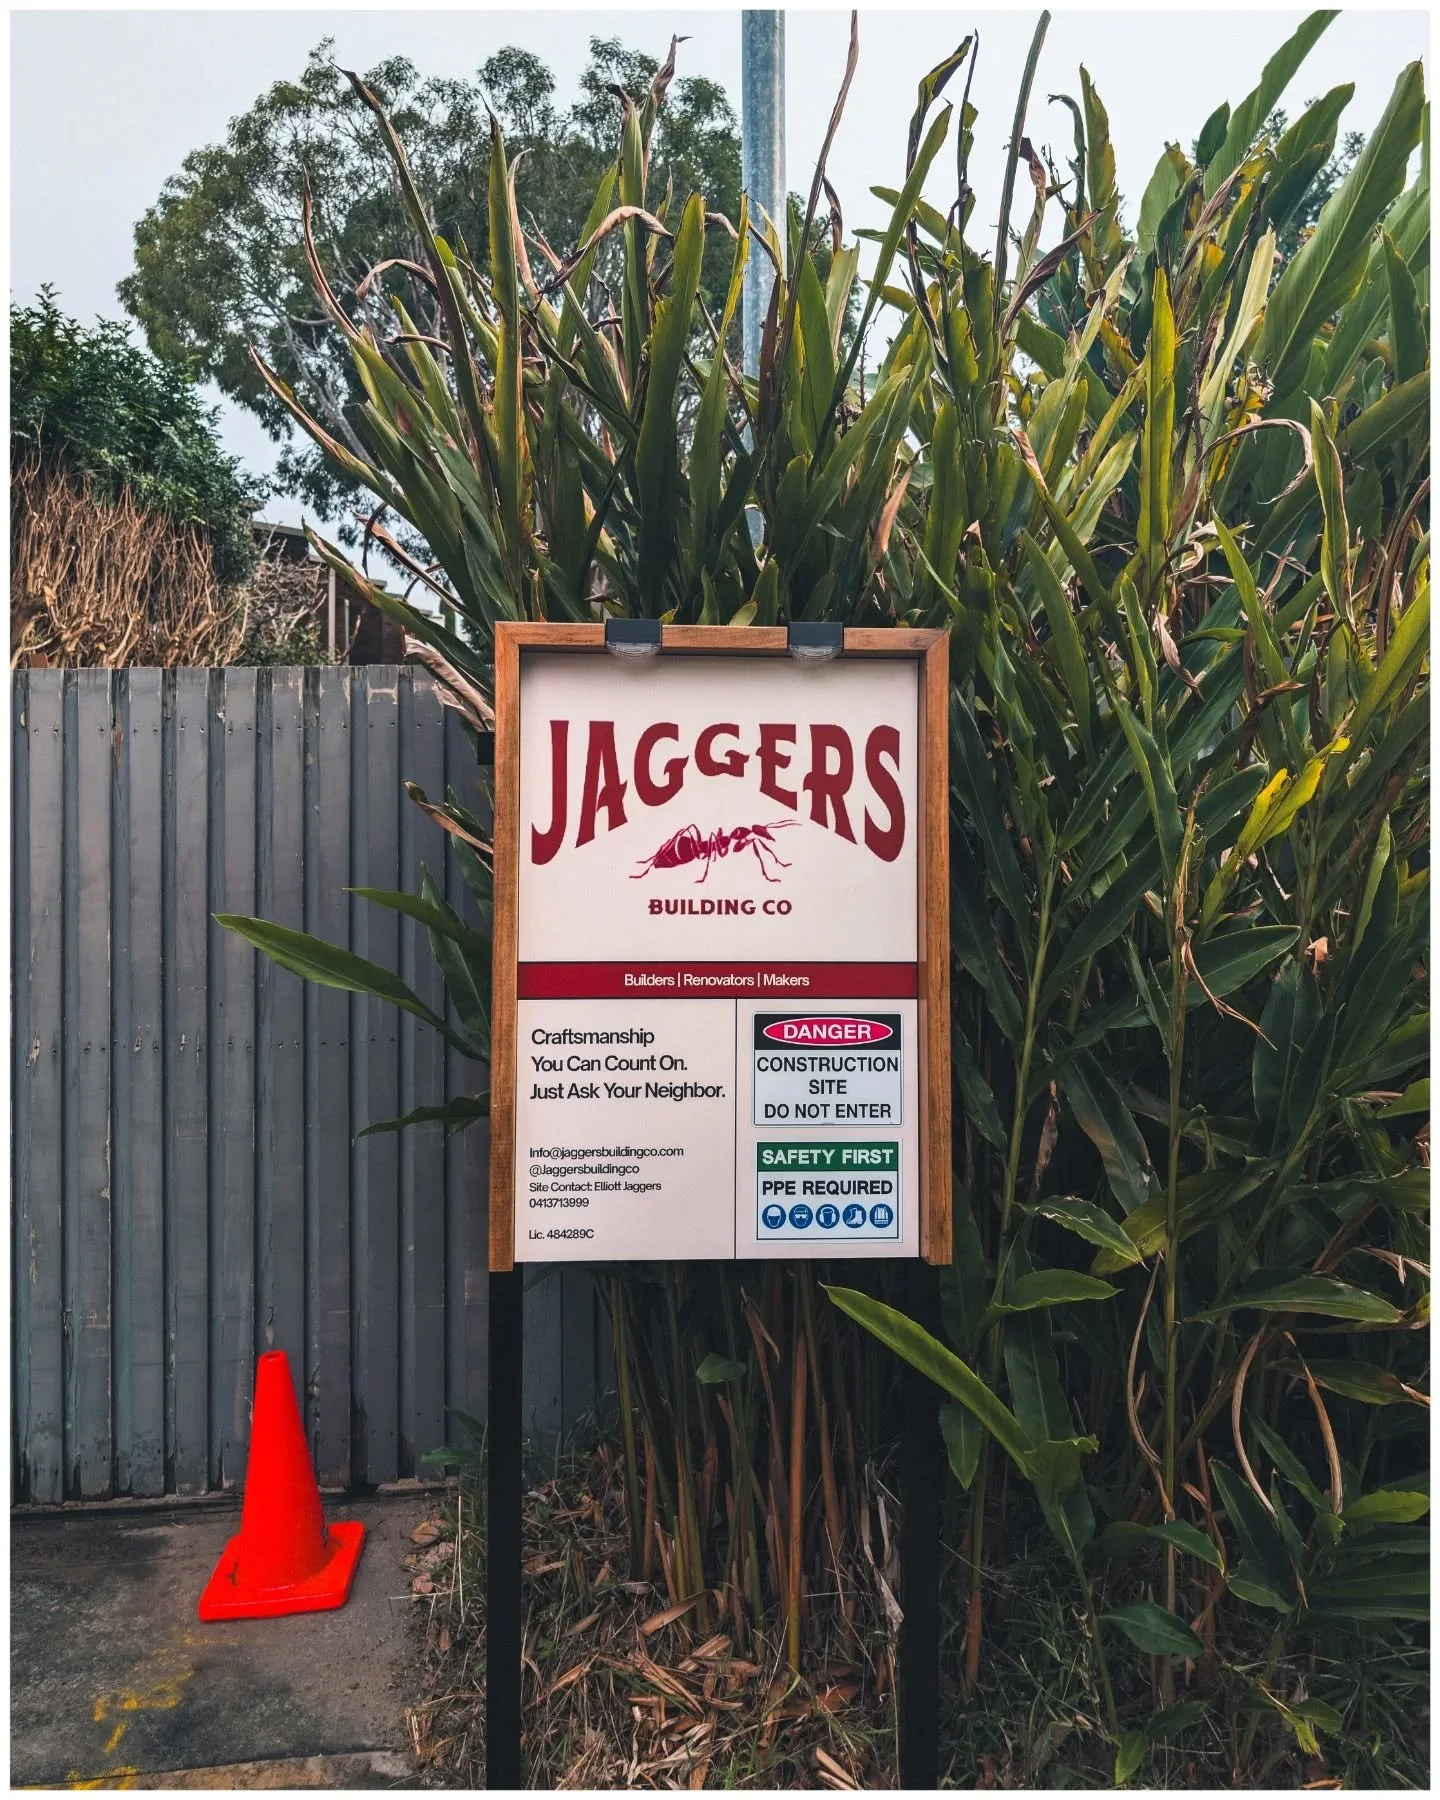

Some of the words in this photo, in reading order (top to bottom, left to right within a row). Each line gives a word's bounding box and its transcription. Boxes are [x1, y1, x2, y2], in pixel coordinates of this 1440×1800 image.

[531, 720, 906, 865] JAGGERS
[648, 899, 756, 915] BUILDING
[762, 900, 792, 915] CO
[625, 974, 675, 986] Builders
[684, 974, 754, 986] Renovators
[763, 974, 809, 986] Makers
[532, 1028, 654, 1047] Craftsmanship
[783, 1024, 871, 1039] DANGER
[531, 1056, 563, 1072] You
[567, 1056, 600, 1071] Can
[605, 1055, 656, 1071] Count
[659, 1055, 687, 1071] On.
[757, 1057, 898, 1072] CONSTRUCTION
[530, 1083, 564, 1100] Just
[567, 1083, 600, 1099] Ask
[604, 1083, 641, 1098] Your
[645, 1082, 726, 1101] Neighbor.
[809, 1079, 847, 1094] SITE
[765, 1104, 789, 1118] DO
[795, 1104, 830, 1118] NOT
[836, 1104, 891, 1118] ENTER
[530, 1147, 683, 1159] Info@jaggersbuildingco.com
[763, 1150, 835, 1164] SAFETY
[842, 1149, 893, 1164] FIRST
[530, 1164, 639, 1177] @Jaggersbuildingco
[529, 1183, 549, 1192] Site
[551, 1182, 592, 1192] Contact:
[594, 1181, 621, 1191] Elliott
[623, 1181, 661, 1193] Jaggers
[763, 1181, 796, 1195] PPE
[803, 1180, 893, 1195] REQUIRED
[529, 1198, 589, 1208] 0413713999
[529, 1230, 545, 1239] Lic.
[547, 1229, 594, 1239] 484289C
